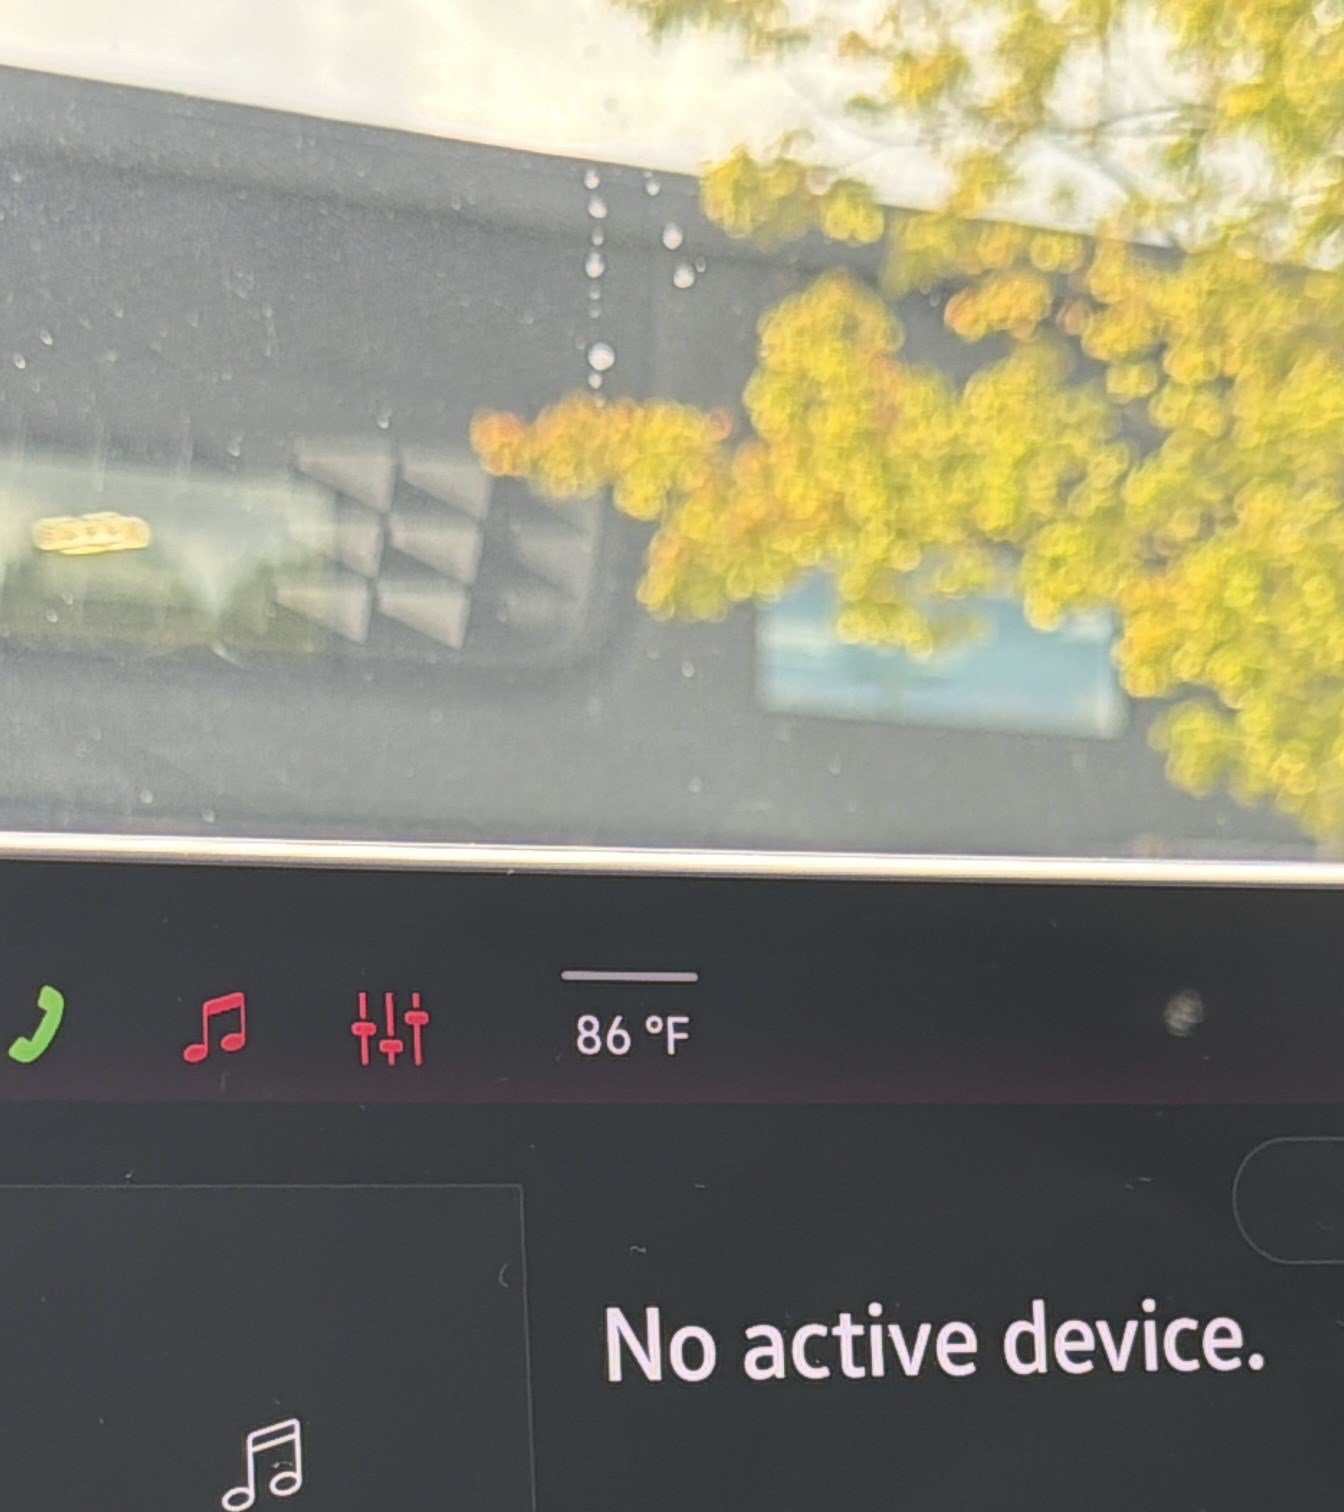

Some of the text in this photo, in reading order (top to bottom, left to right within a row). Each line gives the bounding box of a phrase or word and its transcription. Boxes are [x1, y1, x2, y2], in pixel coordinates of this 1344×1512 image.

[576, 1014, 690, 1056] 86 °F
[605, 1297, 1265, 1382] No active device.
